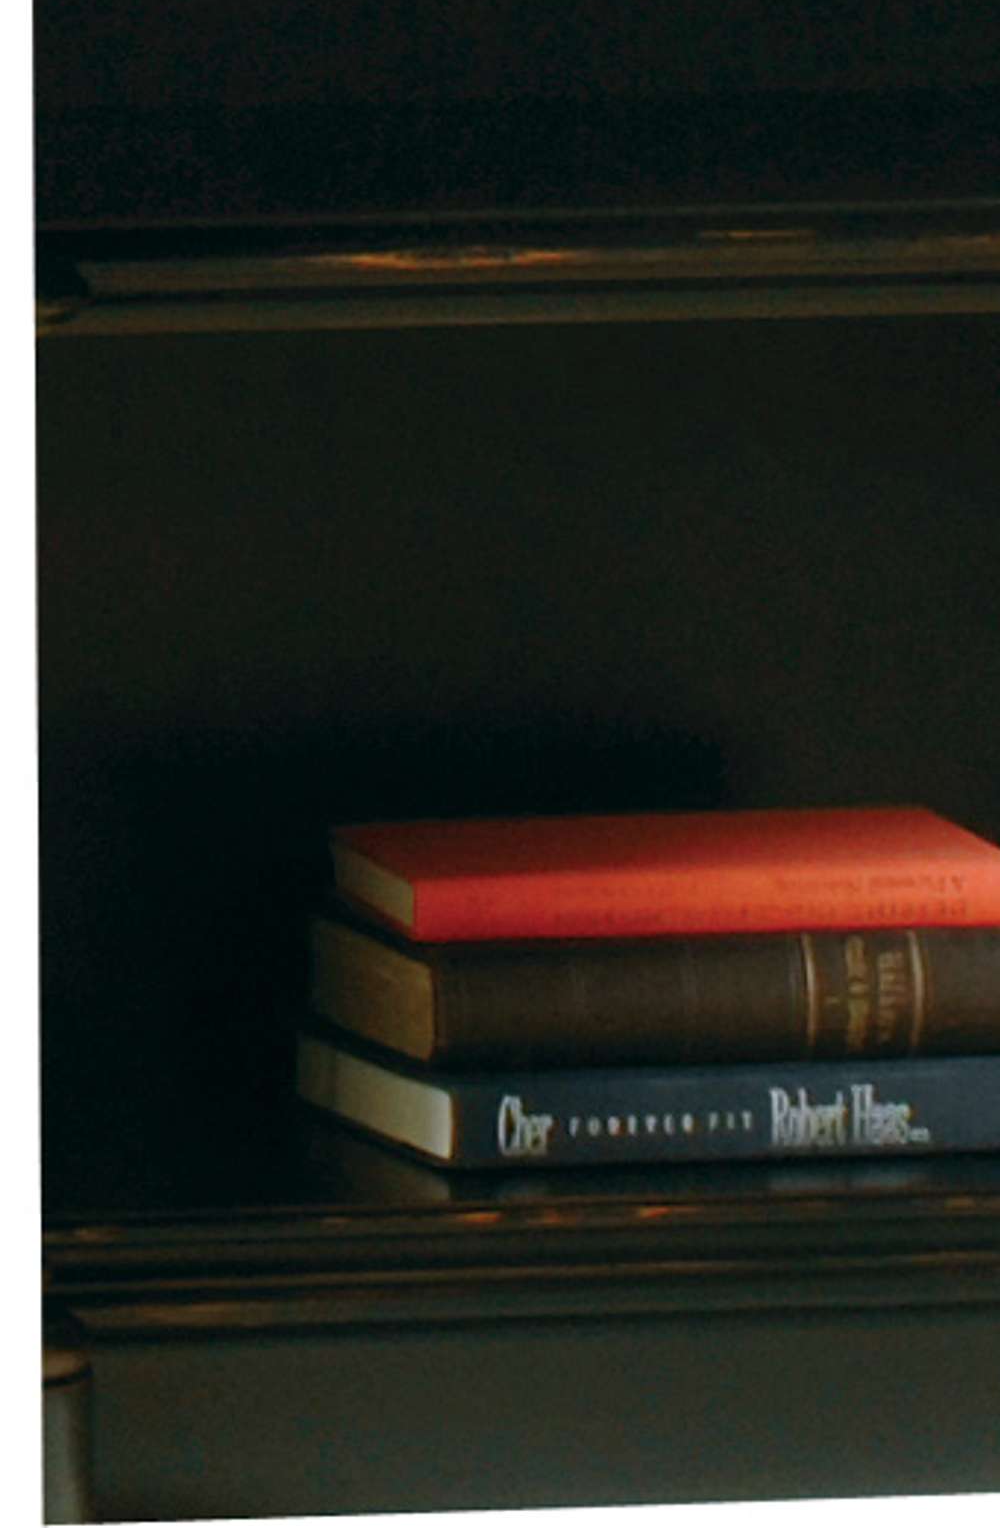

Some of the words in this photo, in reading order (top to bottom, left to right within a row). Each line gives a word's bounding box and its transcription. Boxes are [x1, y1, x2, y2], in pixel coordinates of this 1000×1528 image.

[499, 1094, 554, 1157] Cher
[569, 1112, 695, 1137] FOREVER
[709, 1109, 754, 1132] FIT
[768, 1085, 848, 1147] Robert
